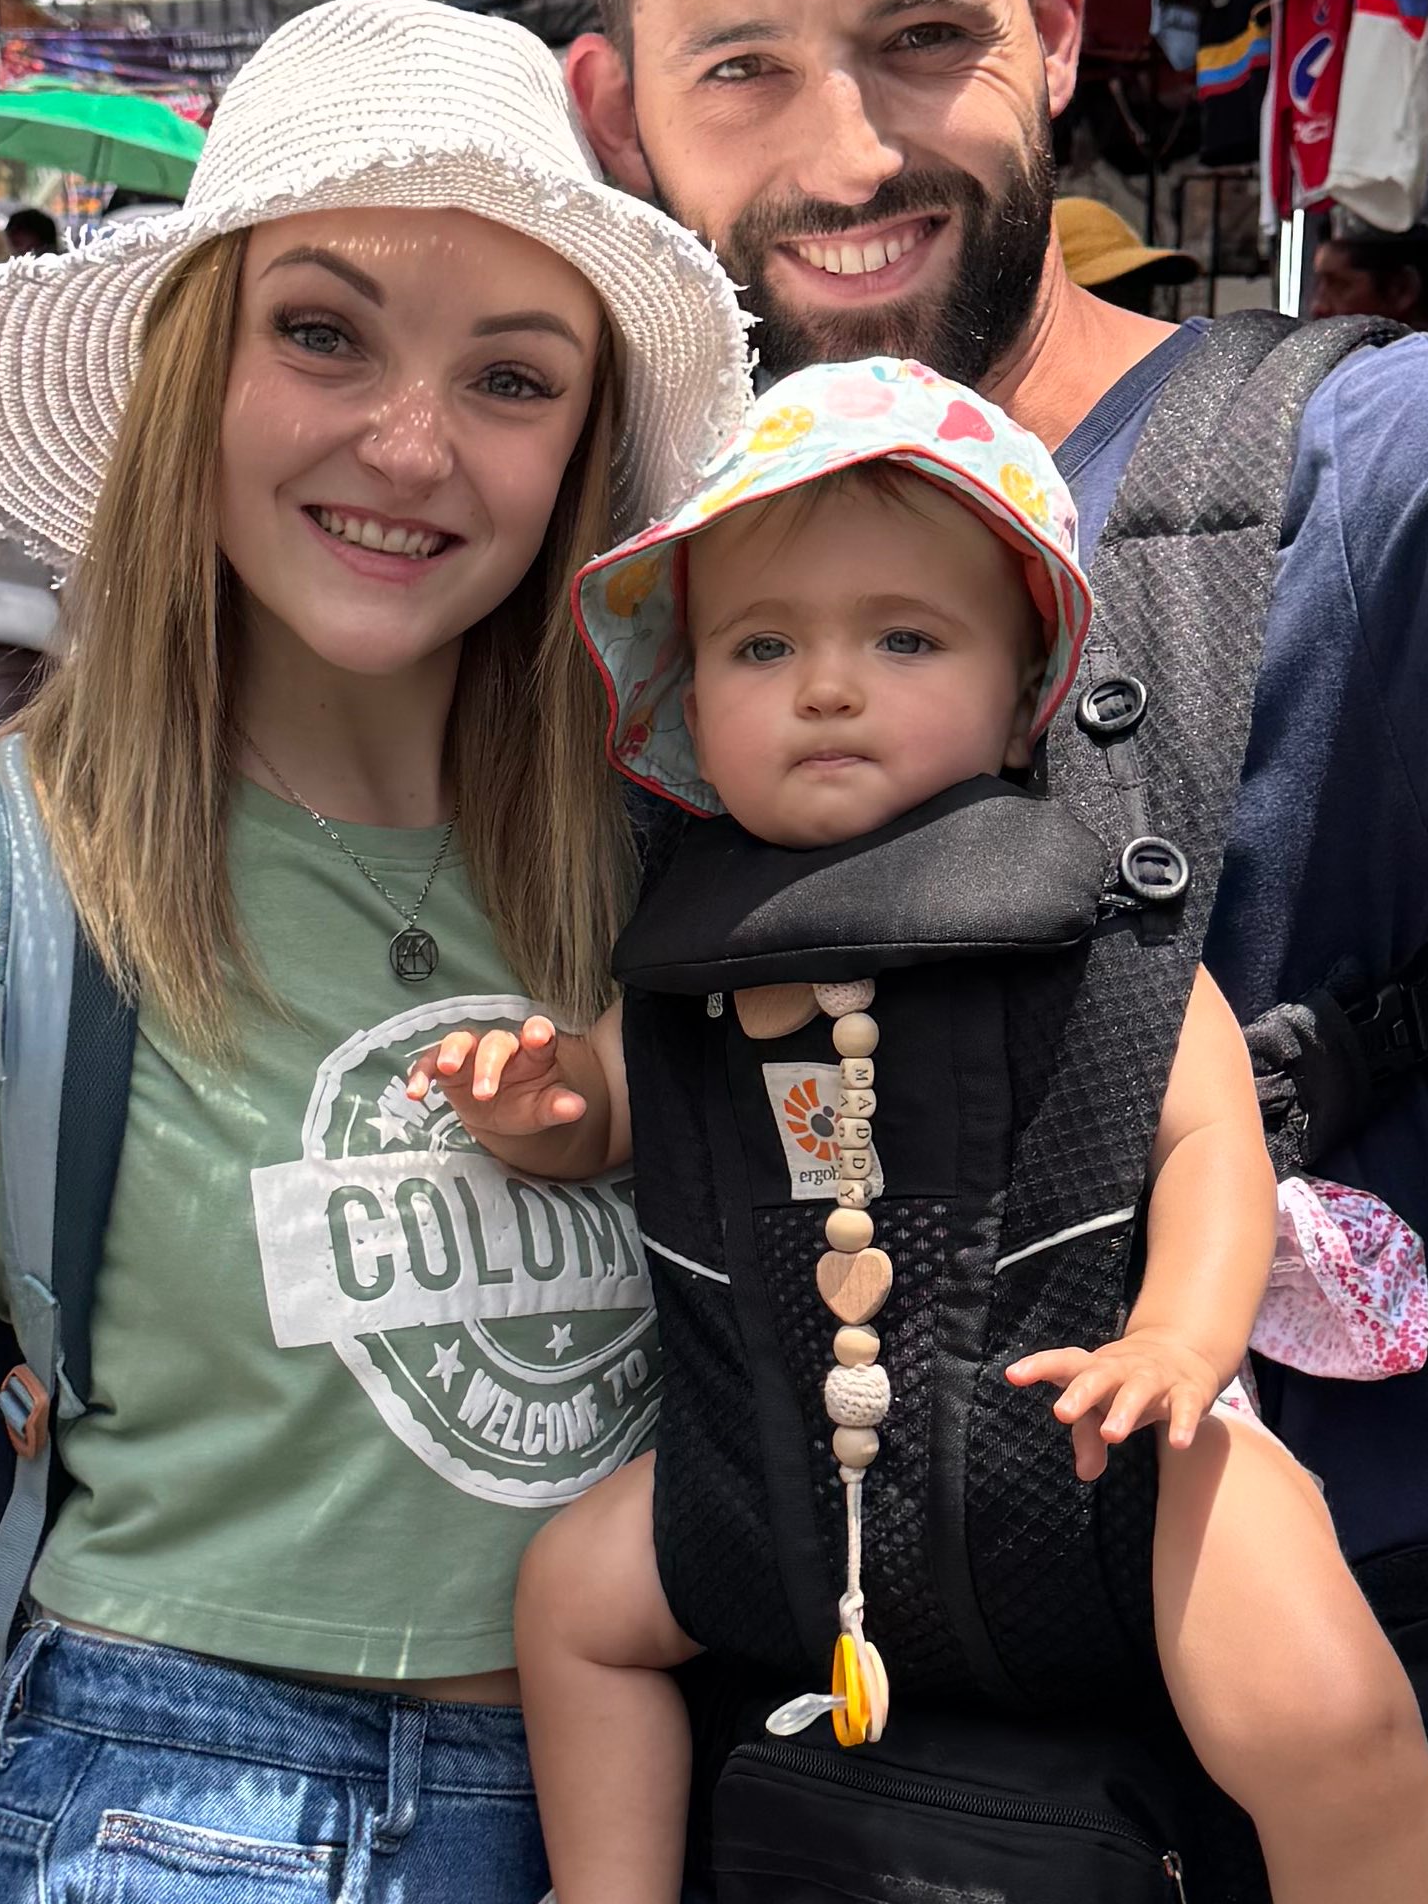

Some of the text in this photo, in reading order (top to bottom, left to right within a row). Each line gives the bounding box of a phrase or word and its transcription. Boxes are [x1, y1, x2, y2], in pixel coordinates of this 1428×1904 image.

[799, 1166, 841, 1186] ergob
[326, 1175, 638, 1303] COLOM
[457, 1348, 648, 1456] WELCOME TO
